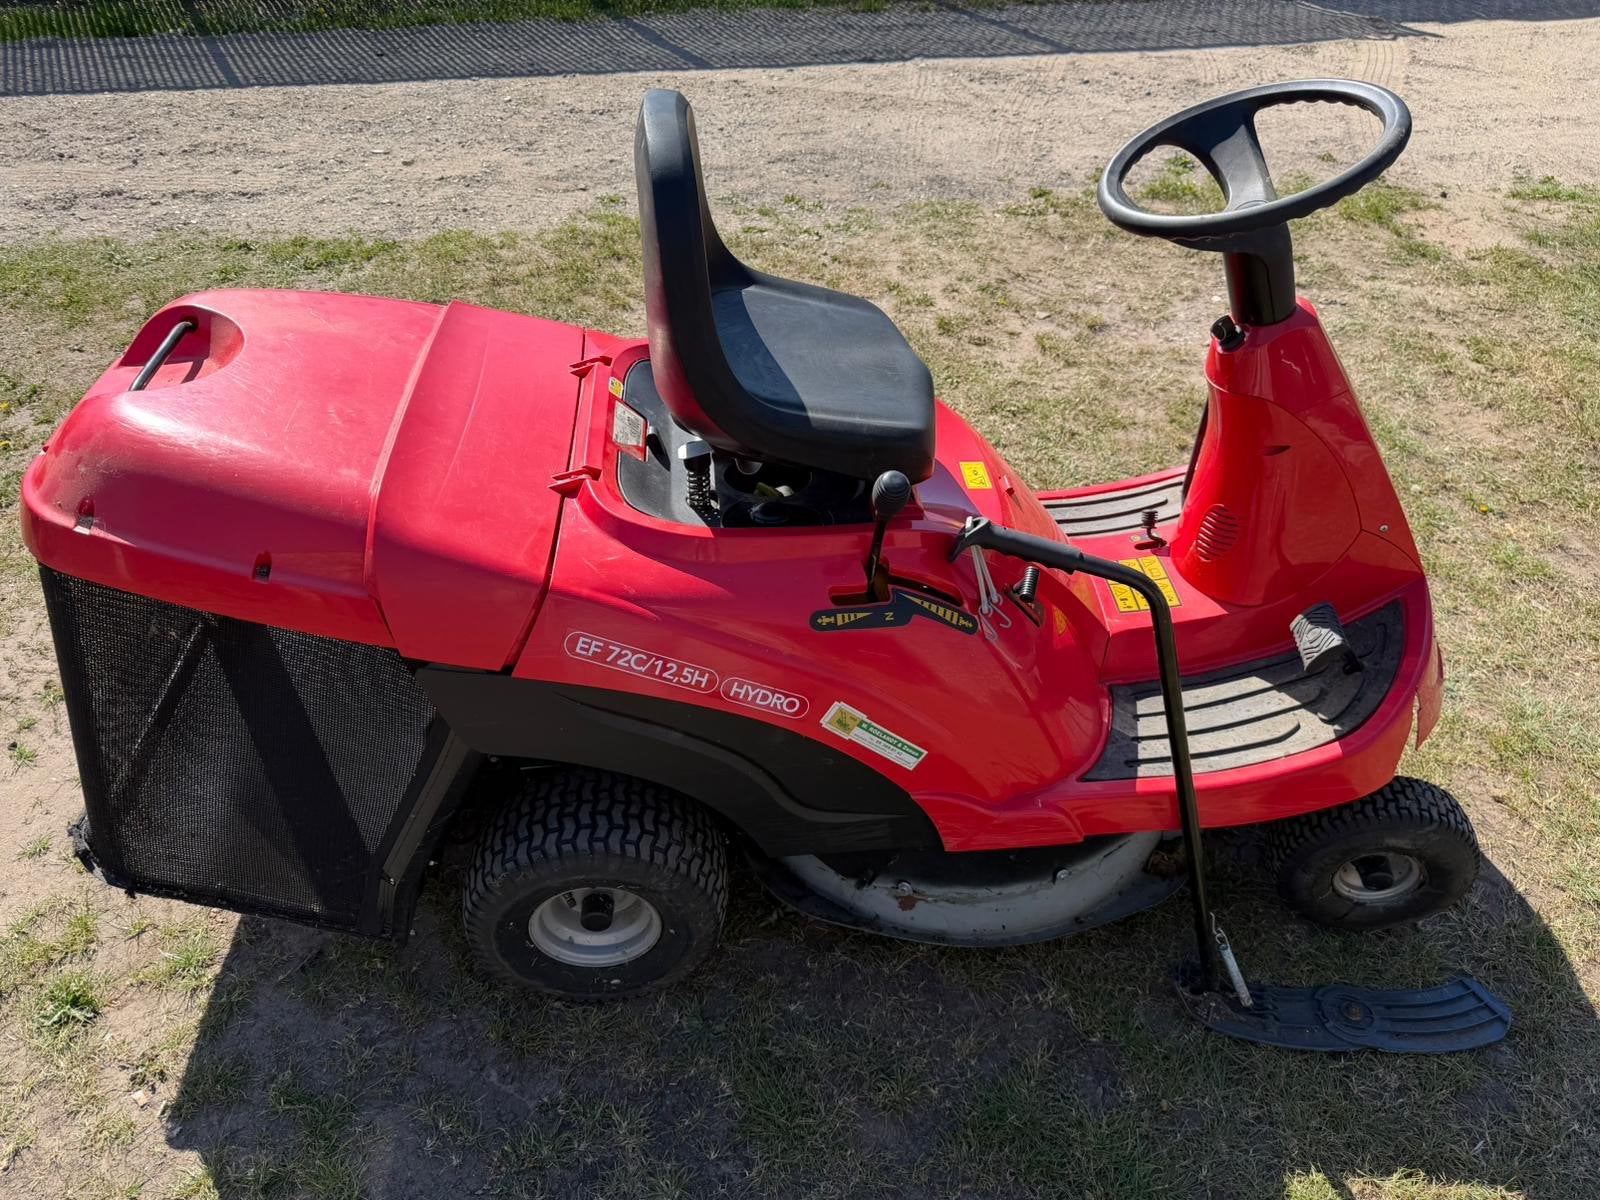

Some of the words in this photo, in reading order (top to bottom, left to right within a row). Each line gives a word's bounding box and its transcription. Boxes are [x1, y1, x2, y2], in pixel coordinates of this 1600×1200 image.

[575, 636, 604, 657] EF
[606, 645, 709, 688] 72C/12,5H
[729, 682, 800, 713] HYDRO
